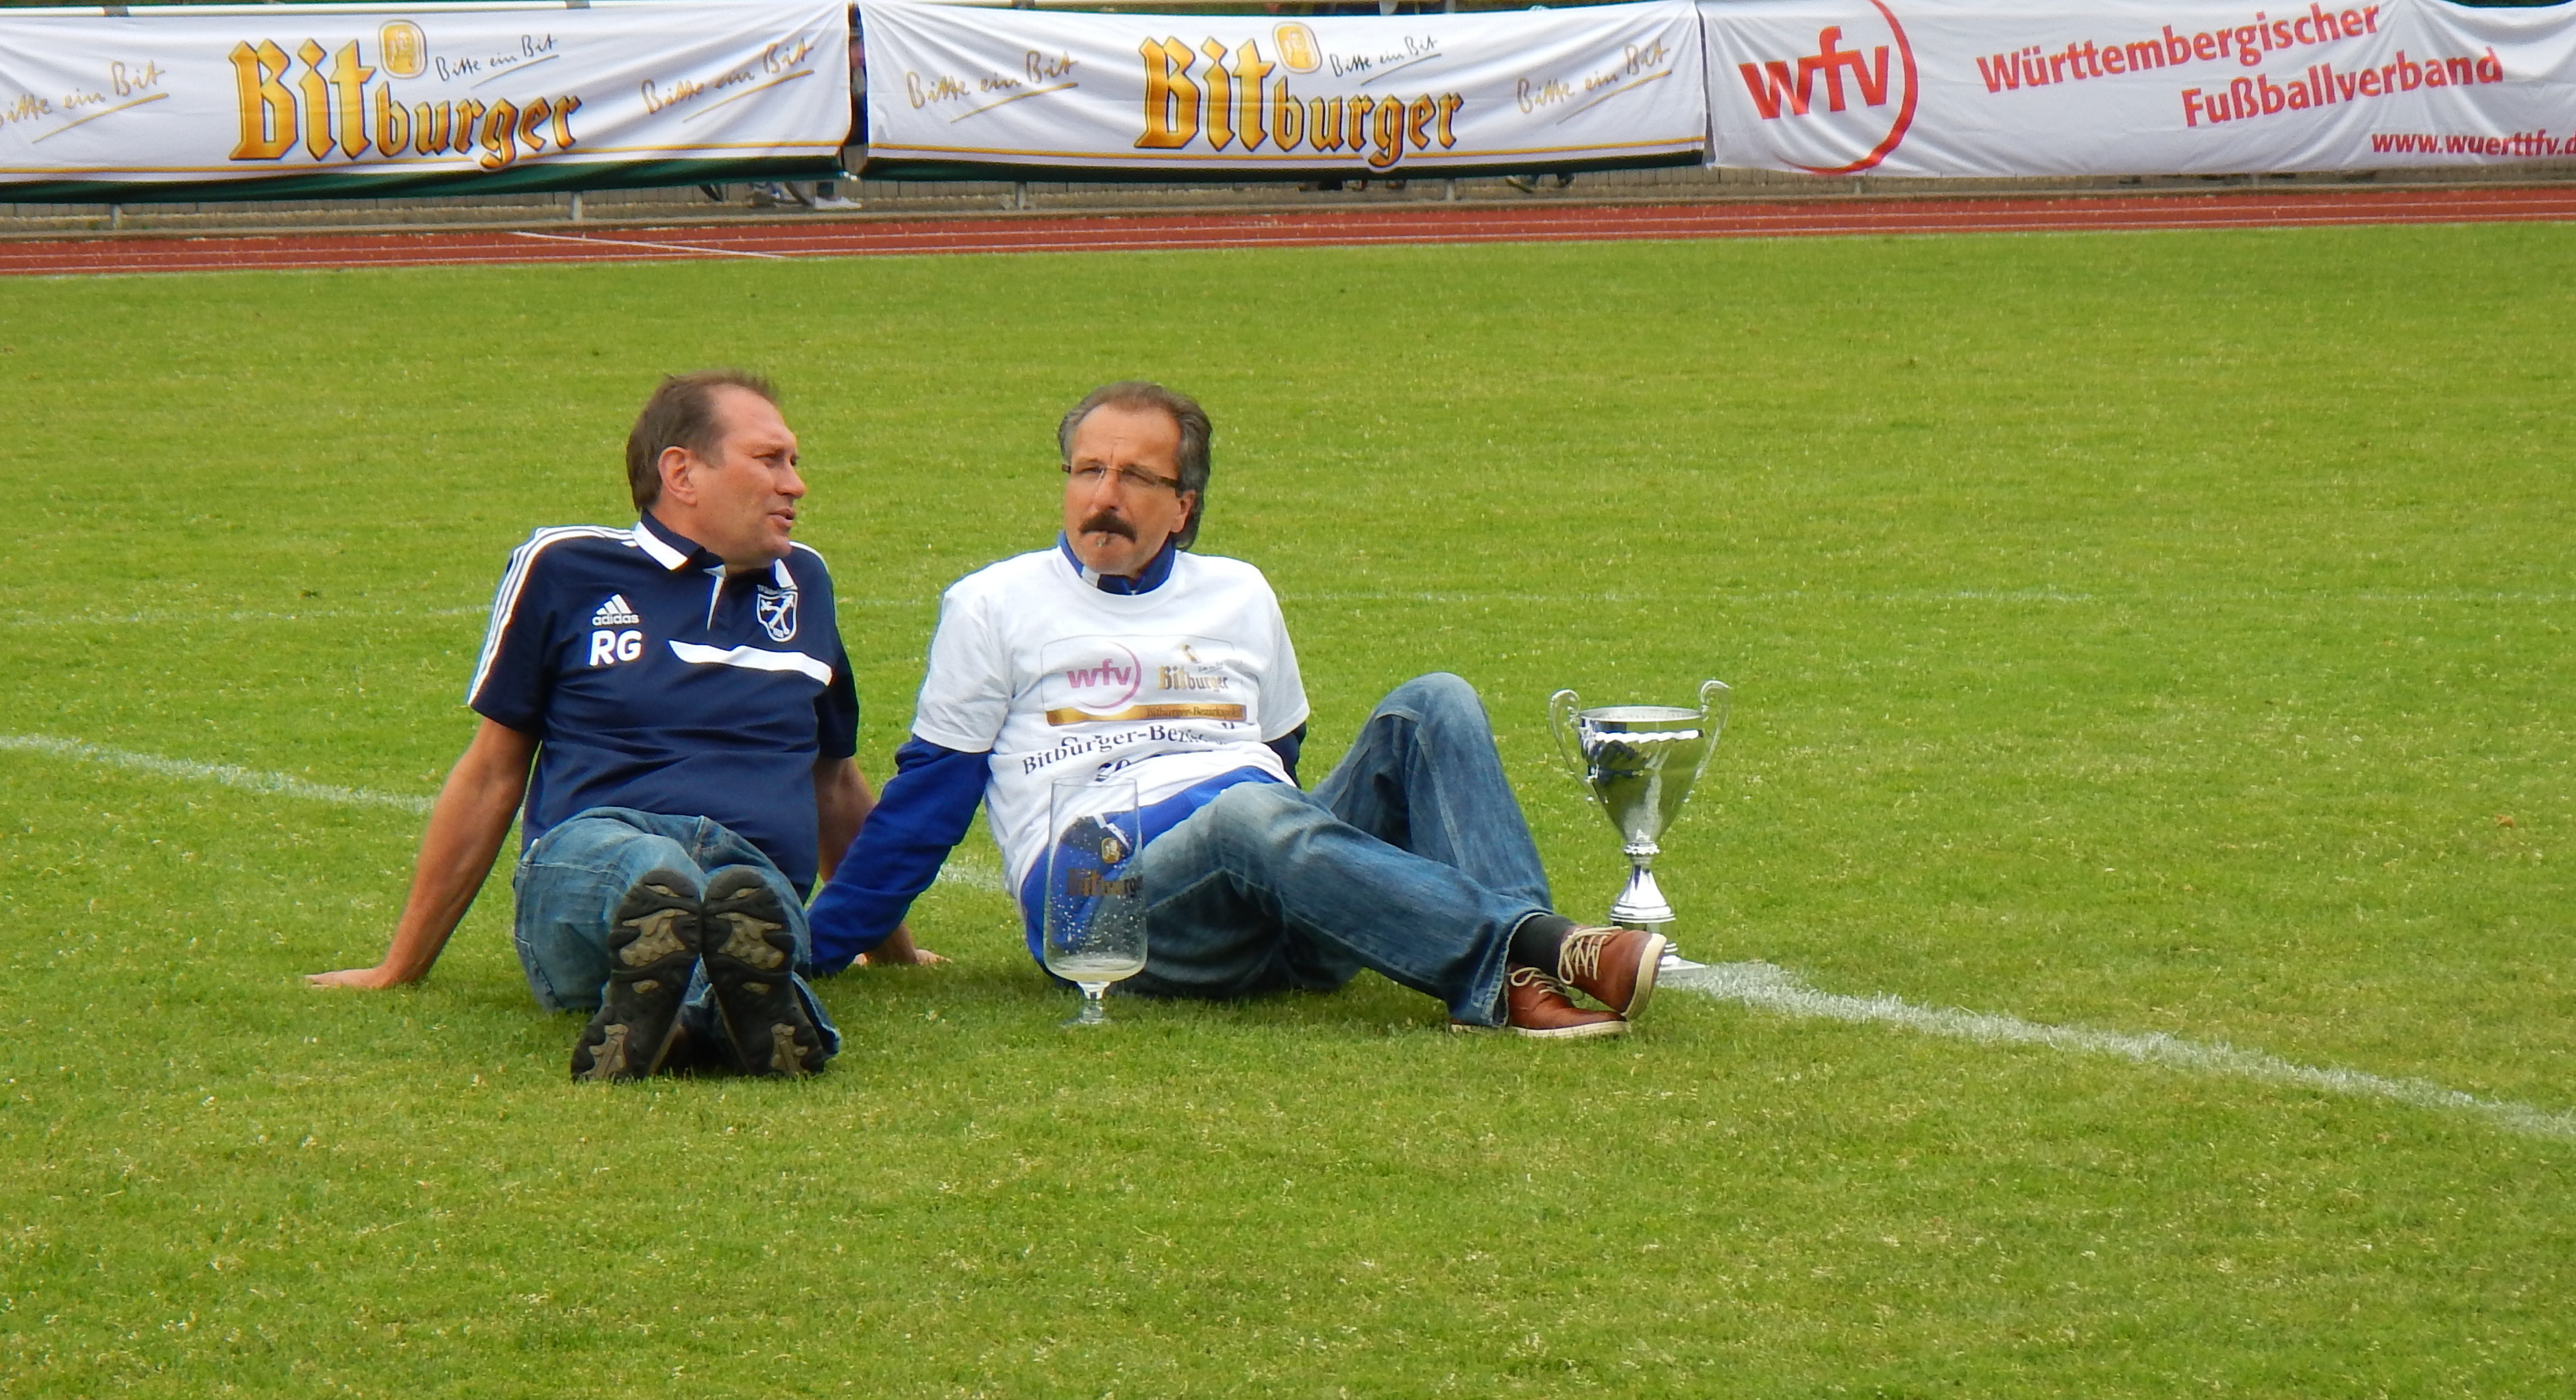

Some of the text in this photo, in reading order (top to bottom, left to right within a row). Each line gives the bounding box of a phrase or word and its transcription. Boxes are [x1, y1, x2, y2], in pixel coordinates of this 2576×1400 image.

[435, 33, 557, 82] Bitte ein Bit
[641, 79, 704, 114] Bitte
[763, 37, 814, 73] Bit
[906, 50, 1079, 109] Bitte ein Bit
[1329, 34, 1438, 77] Bitte ein Bit
[1517, 38, 1670, 114] Bitte ein Bit
[1738, 25, 1890, 119] wfv
[1976, 3, 2379, 93] Württembergischer
[0, 60, 165, 128] itte ein Bit
[228, 38, 581, 169] Bitburger
[1134, 36, 1463, 168] Bitburger
[2181, 47, 2503, 128] Fußballverband
[590, 629, 643, 666] RG
[592, 613, 640, 627] adidas
[1067, 658, 1132, 689] wfv
